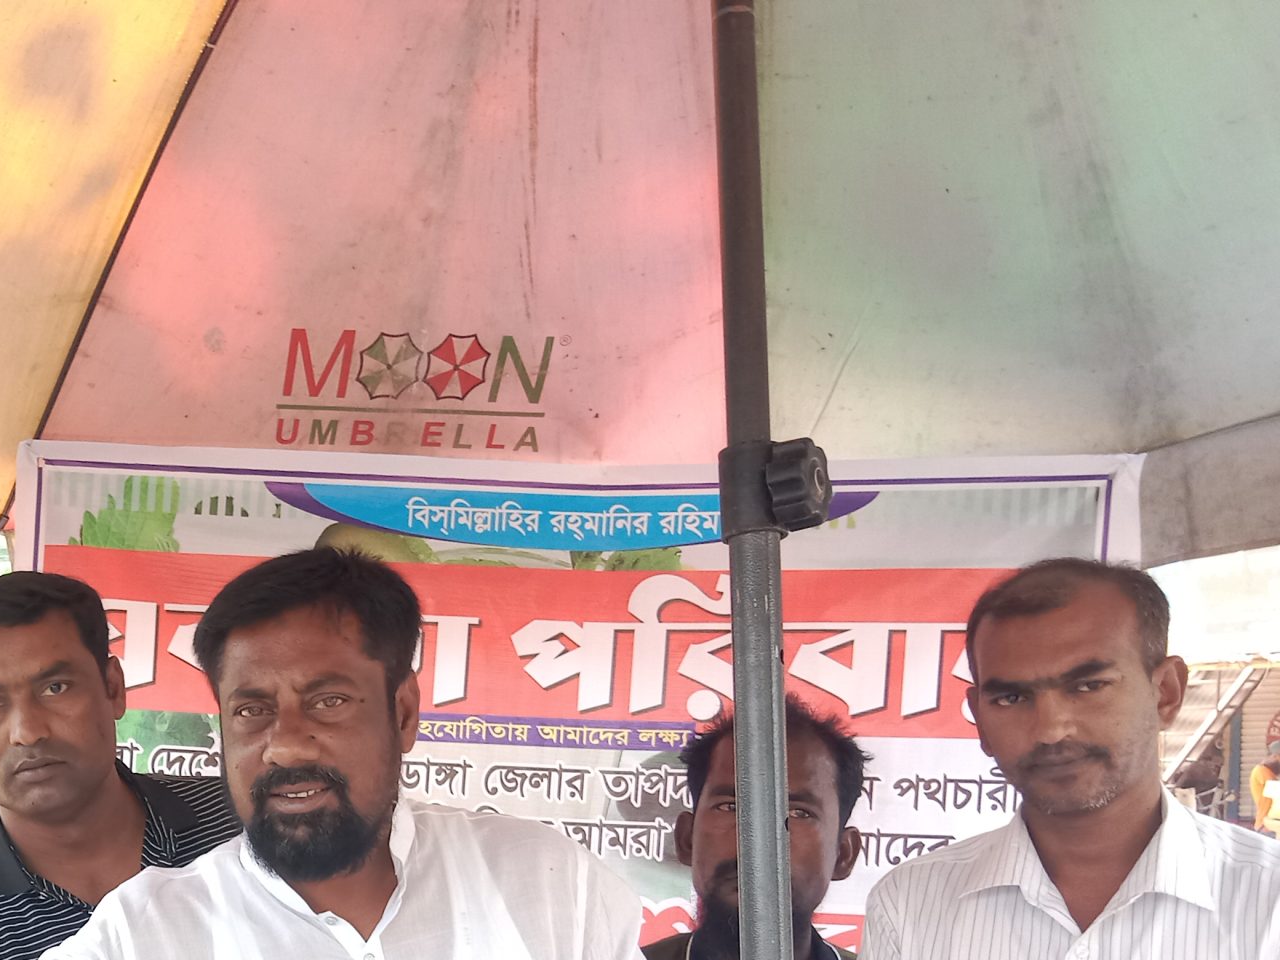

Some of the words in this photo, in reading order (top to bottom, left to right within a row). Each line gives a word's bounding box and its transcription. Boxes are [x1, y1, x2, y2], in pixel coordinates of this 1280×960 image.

[658, 502, 720, 537] রহিম
[511, 573, 976, 724] পরিবা
[417, 716, 532, 741] হযোগিতায়
[536, 725, 631, 746] আমাদের
[637, 729, 692, 748] লক্ষ্য
[400, 757, 473, 795] ডাঙ্গা
[485, 763, 591, 800] জেলার
[599, 766, 691, 803] তাপদ
[561, 819, 671, 860] আমরা
